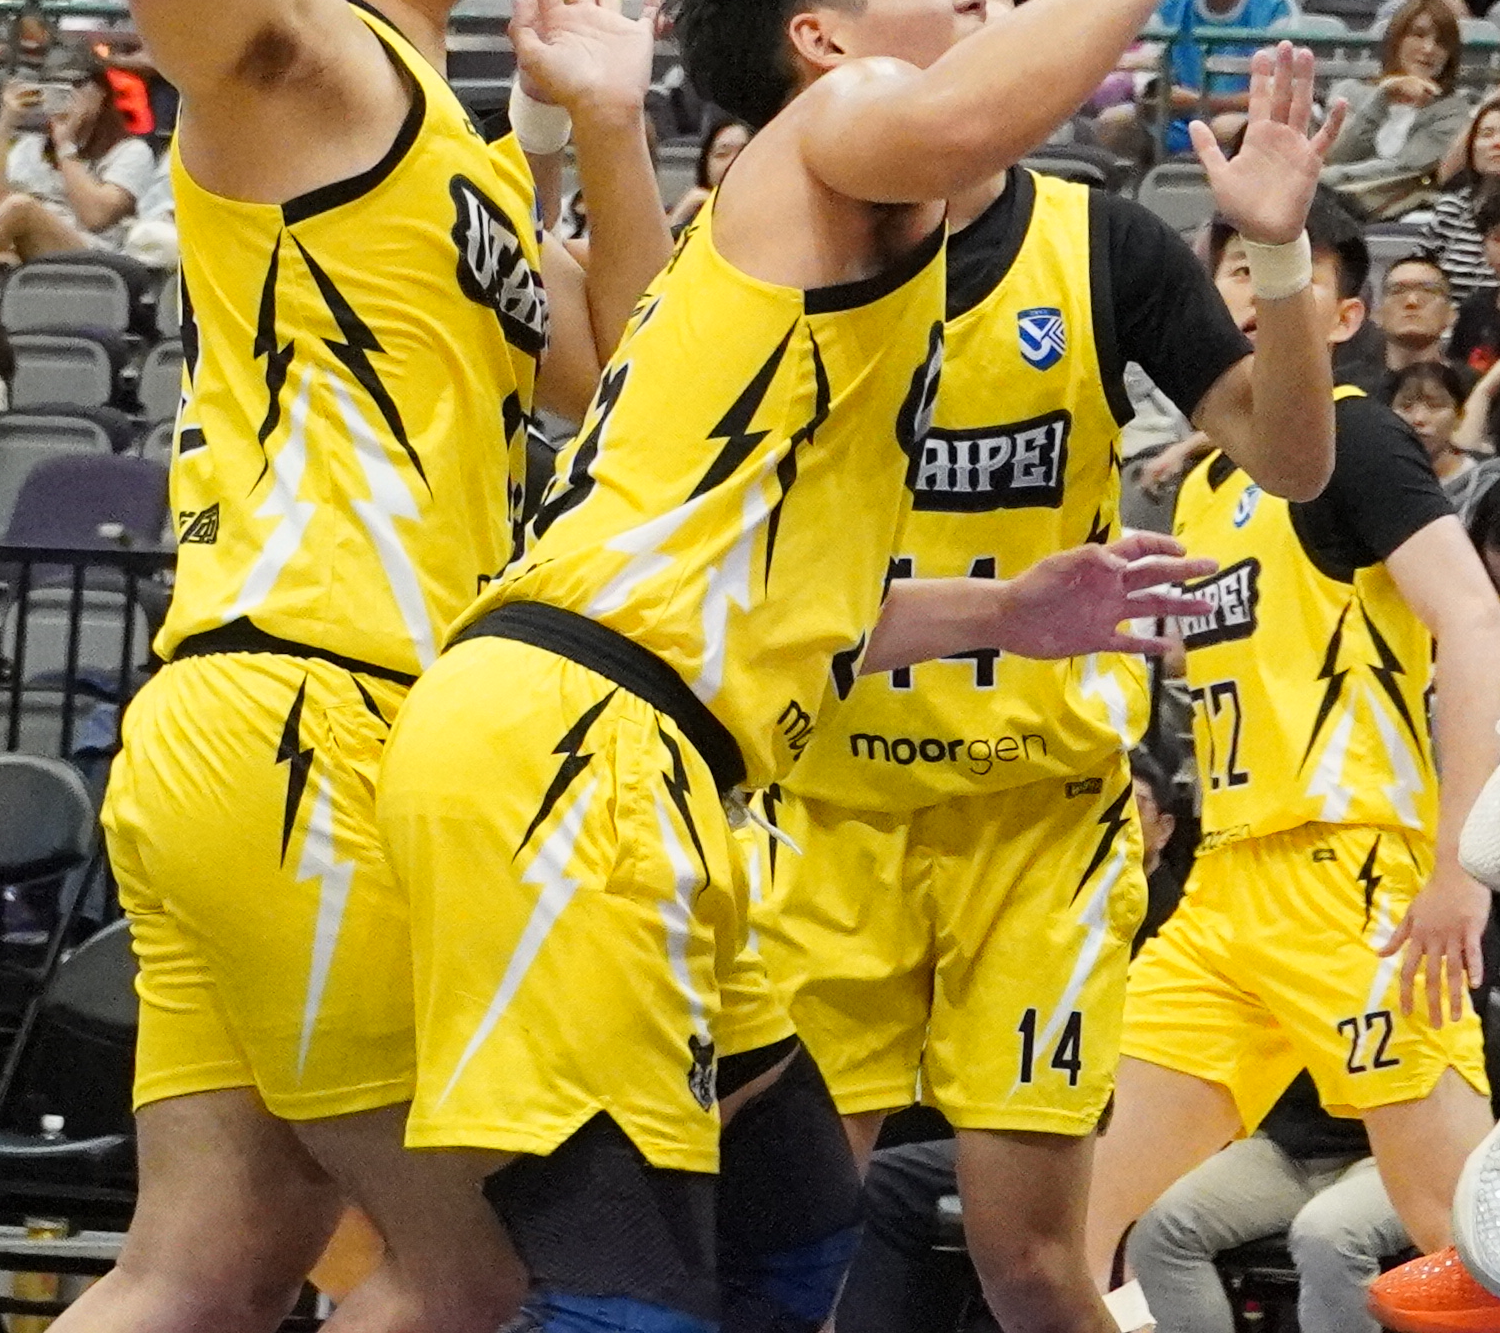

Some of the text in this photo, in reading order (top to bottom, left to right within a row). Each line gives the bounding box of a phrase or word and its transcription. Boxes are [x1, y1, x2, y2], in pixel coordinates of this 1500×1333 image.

[850, 733, 1047, 775] moorgen
[1017, 1007, 1083, 1087] 14
[1337, 1010, 1401, 1075] 22
